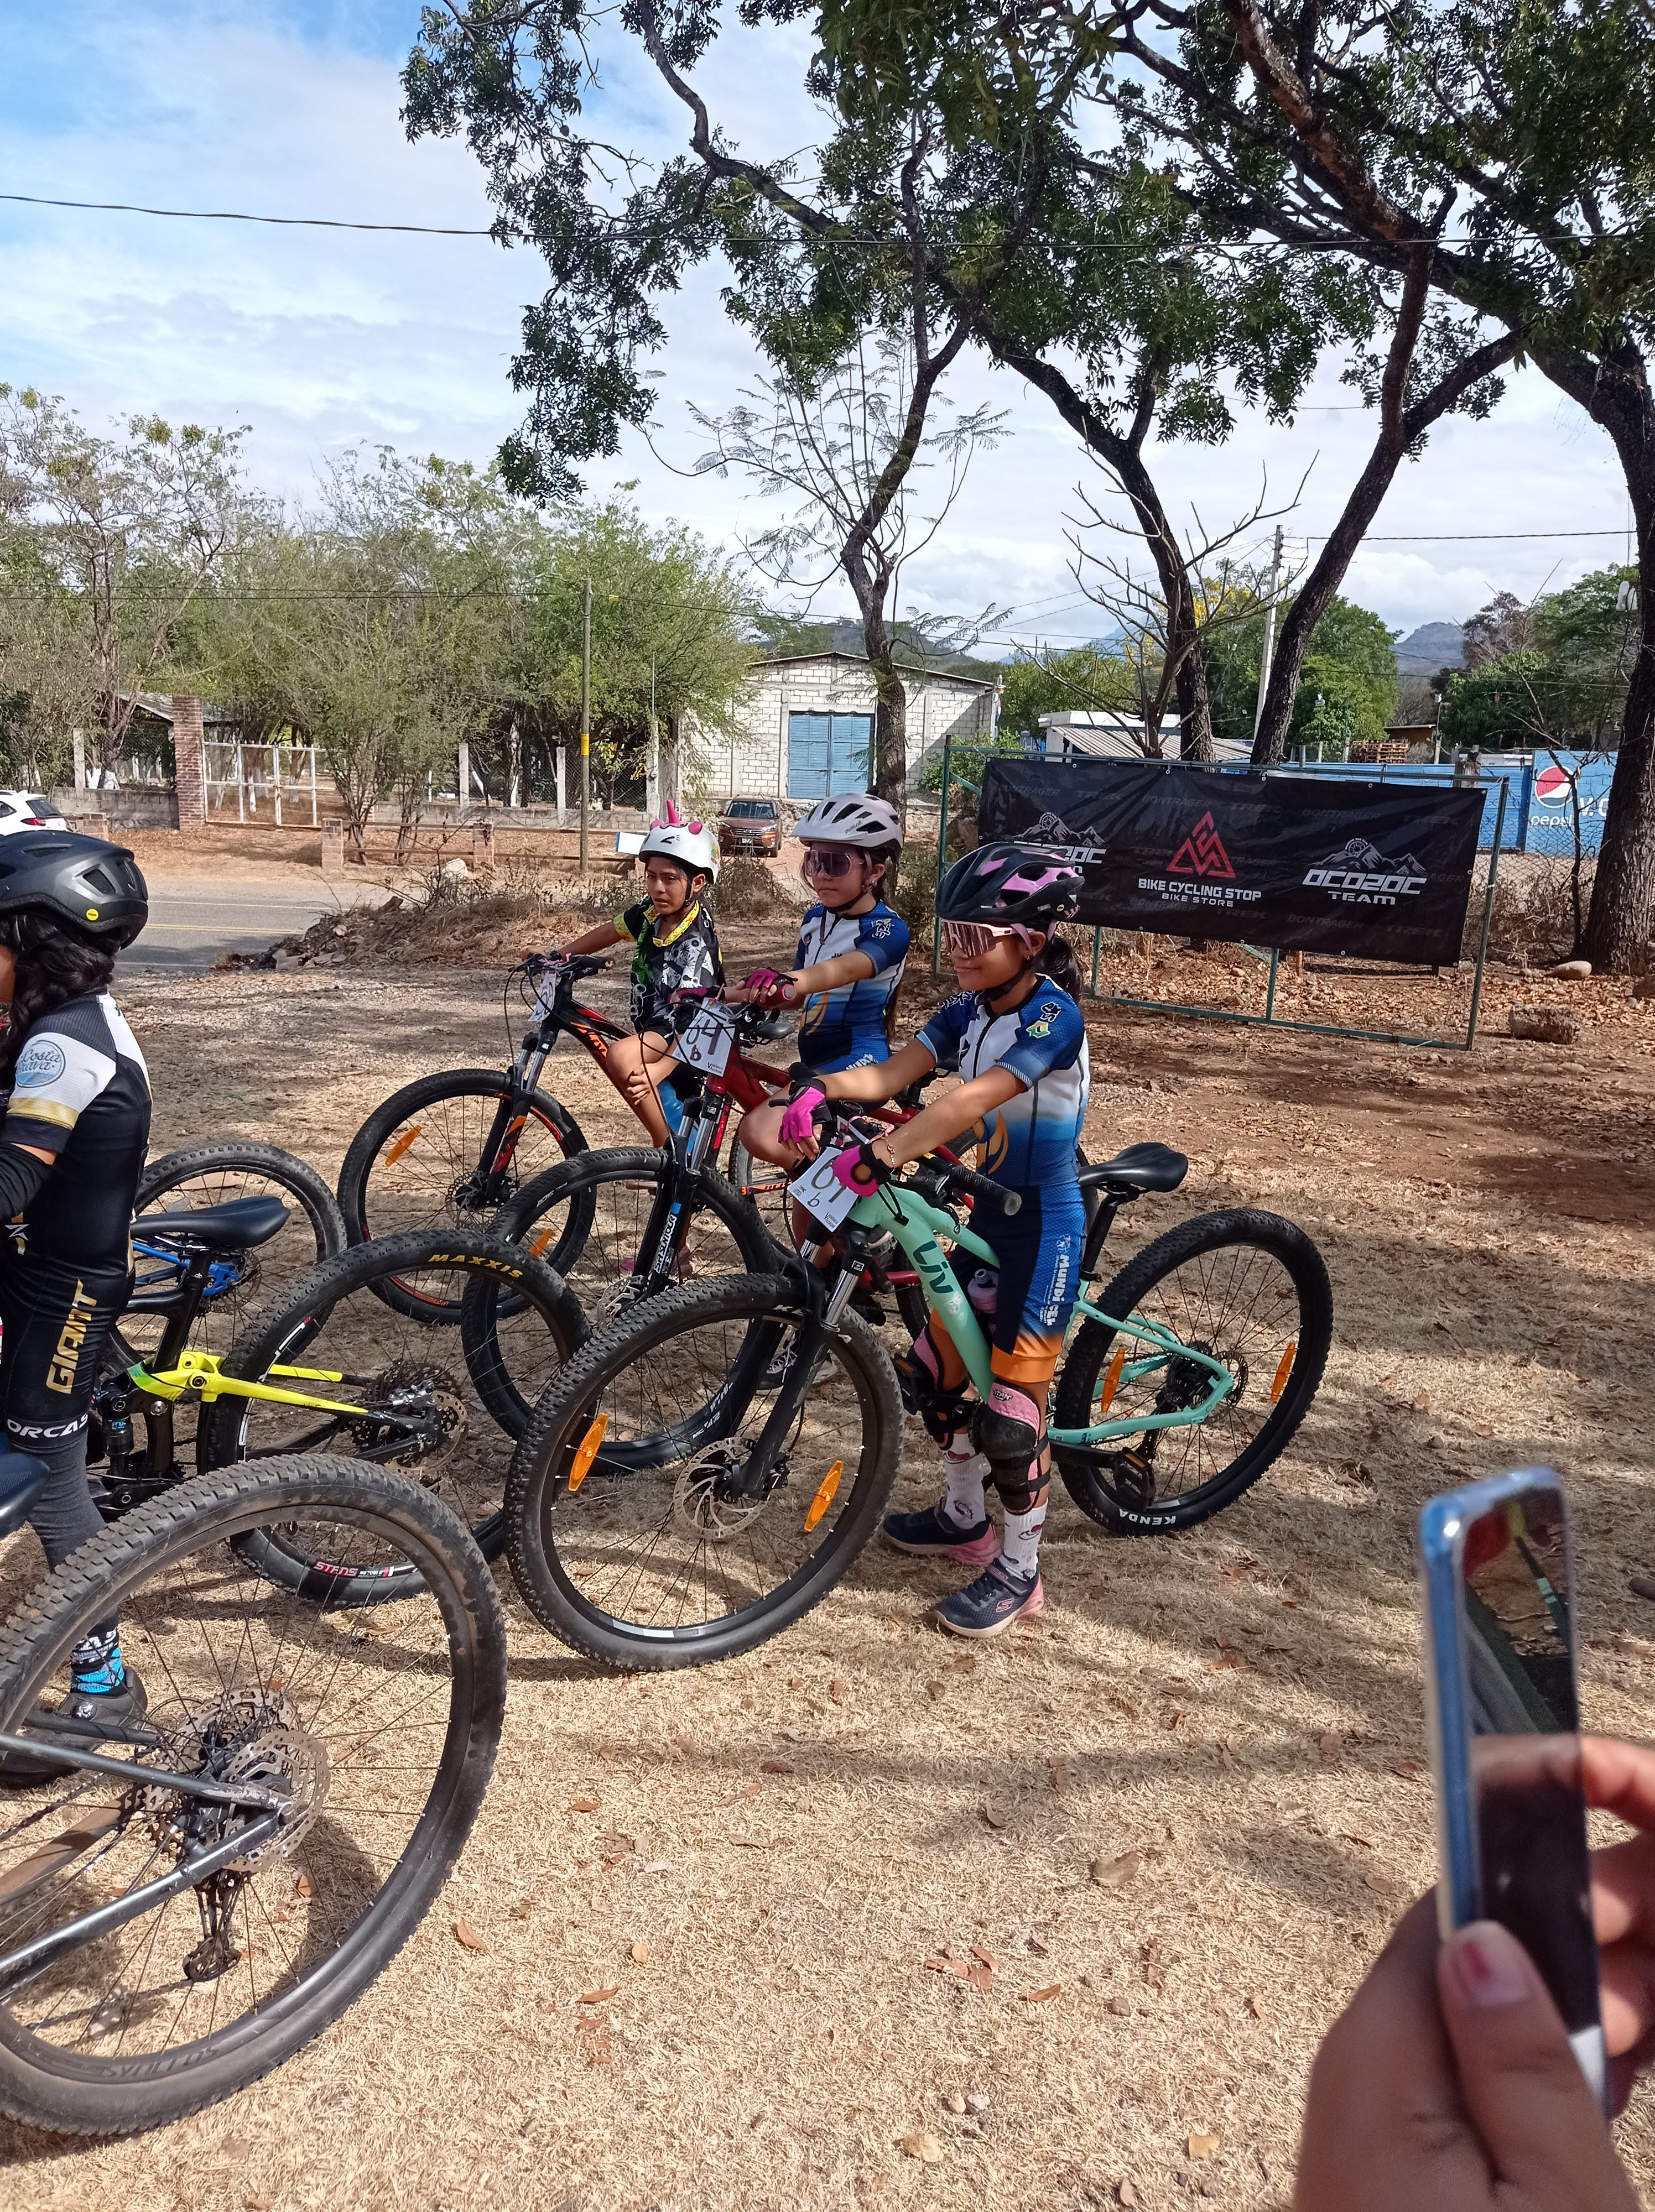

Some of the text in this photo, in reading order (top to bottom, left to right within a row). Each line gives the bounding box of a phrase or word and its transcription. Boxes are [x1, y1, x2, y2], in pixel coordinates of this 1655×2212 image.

[1531, 814, 1573, 828] pepsi
[1138, 878, 1262, 901] BIKE CYCLING STOP
[1328, 891, 1396, 905] TEAM
[1162, 893, 1234, 907] BIKE STORE
[428, 1254, 524, 1278] MAXXIS
[46, 1279, 97, 1394] GIANT
[7, 1412, 89, 1438] ORCAS
[1119, 1508, 1176, 1525] KENDA
